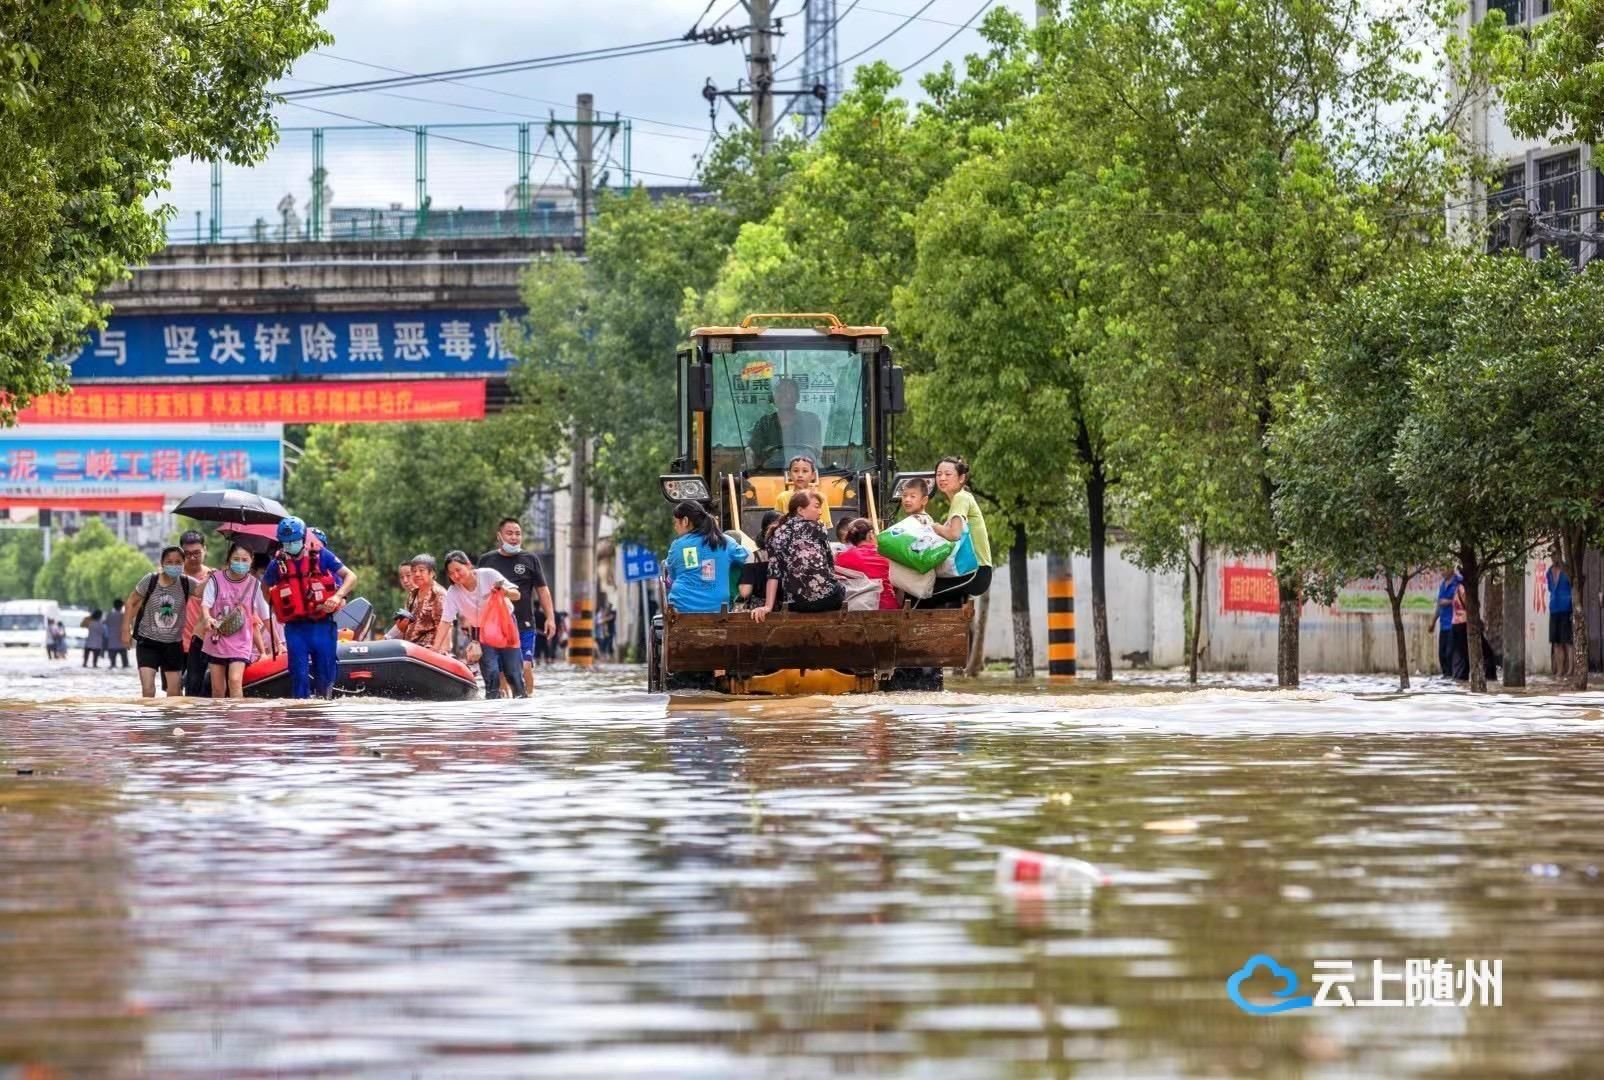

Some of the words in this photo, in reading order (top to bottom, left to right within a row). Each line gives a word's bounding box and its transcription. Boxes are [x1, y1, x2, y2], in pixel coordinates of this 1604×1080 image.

[0, 449, 38, 481] 泥
[53, 449, 250, 482] 三峡工程作证
